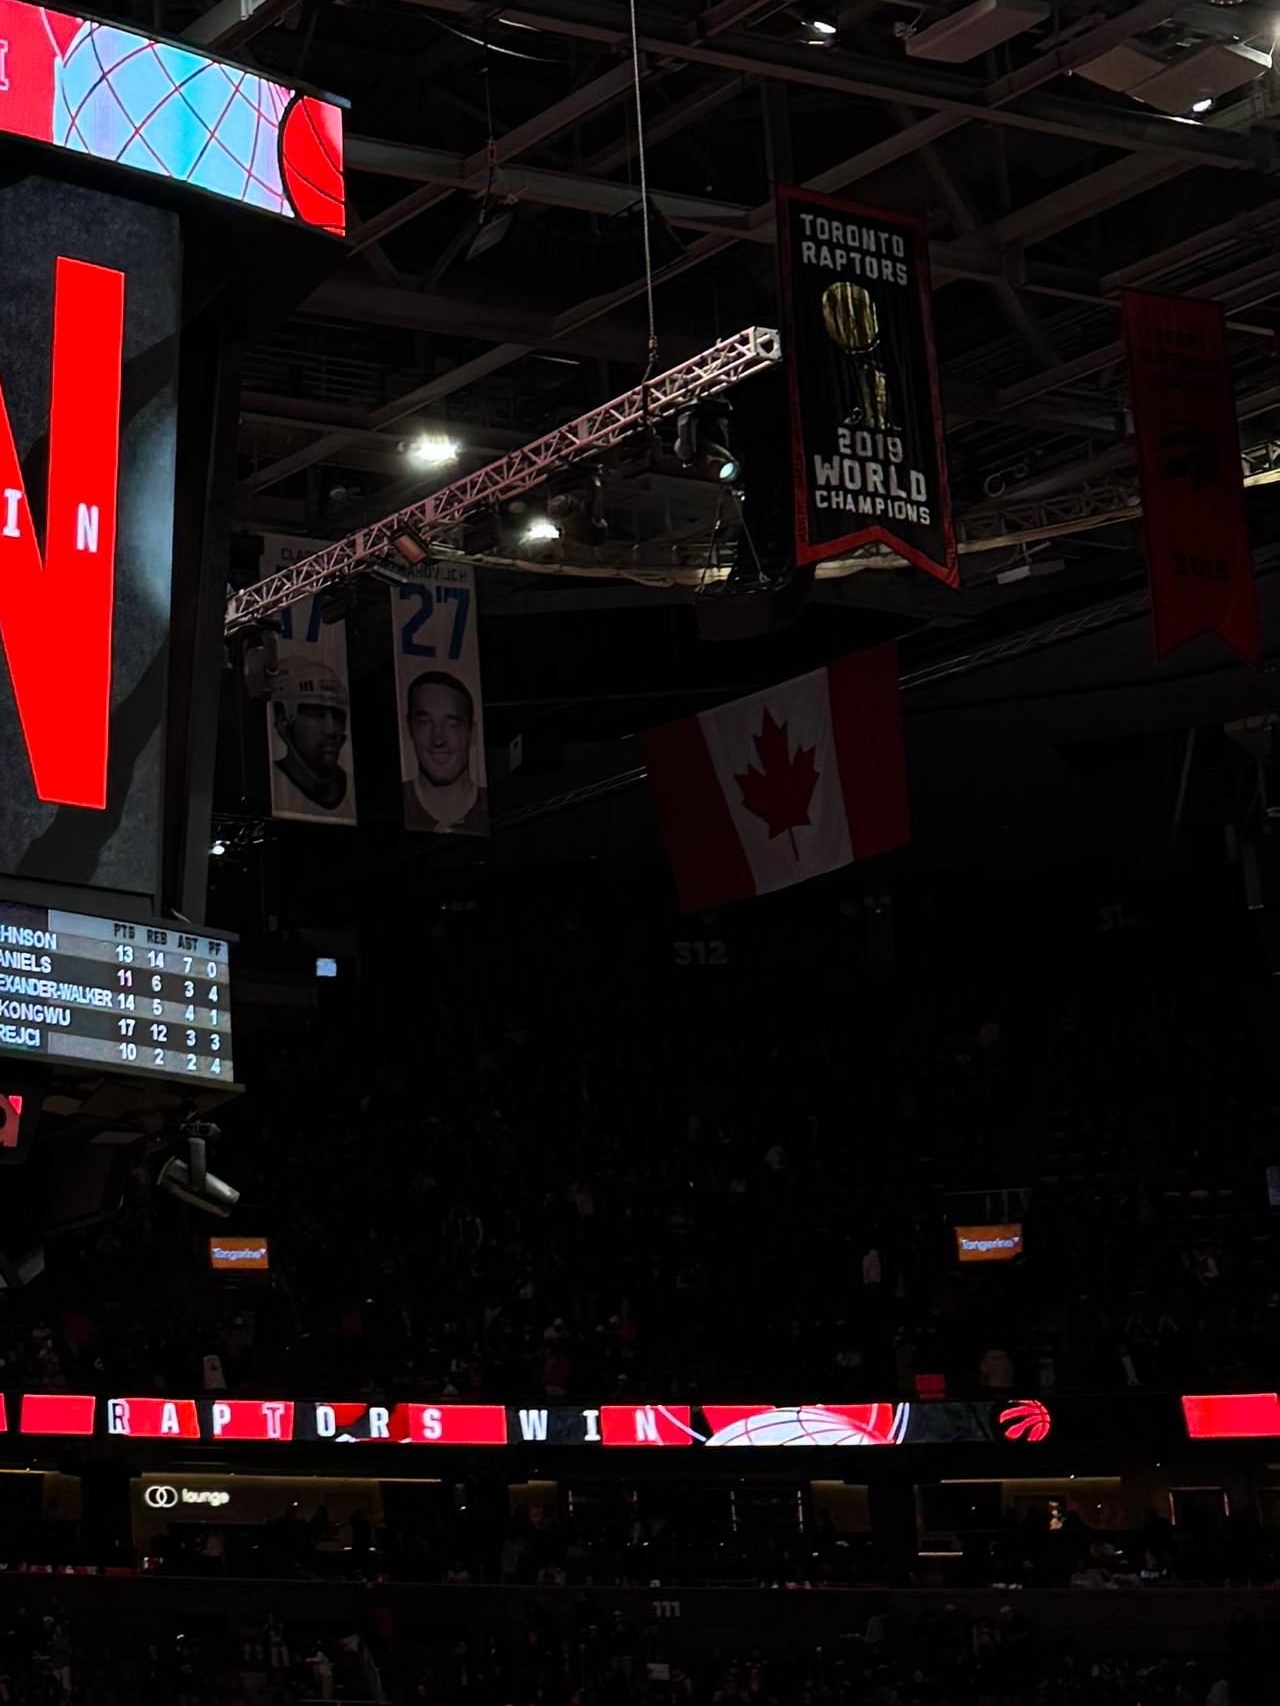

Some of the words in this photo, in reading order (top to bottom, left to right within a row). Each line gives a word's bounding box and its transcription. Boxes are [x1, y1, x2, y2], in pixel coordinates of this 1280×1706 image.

[801, 214, 904, 258] TORONTO
[802, 241, 907, 286] RAPTORS
[838, 427, 903, 463] 2019
[814, 454, 927, 502] WORLD
[815, 490, 930, 525] CHAMPIONS
[399, 583, 470, 660] 27
[116, 945, 134, 963] 13
[117, 969, 132, 986] 11
[118, 993, 135, 1011] 14
[119, 1018, 135, 1037] 17
[119, 1042, 136, 1061] 10
[108, 1398, 442, 1440] RAPTORS
[519, 1405, 656, 1443] WIN
[182, 1488, 230, 1506] lounge
[651, 1599, 680, 1617] 111
